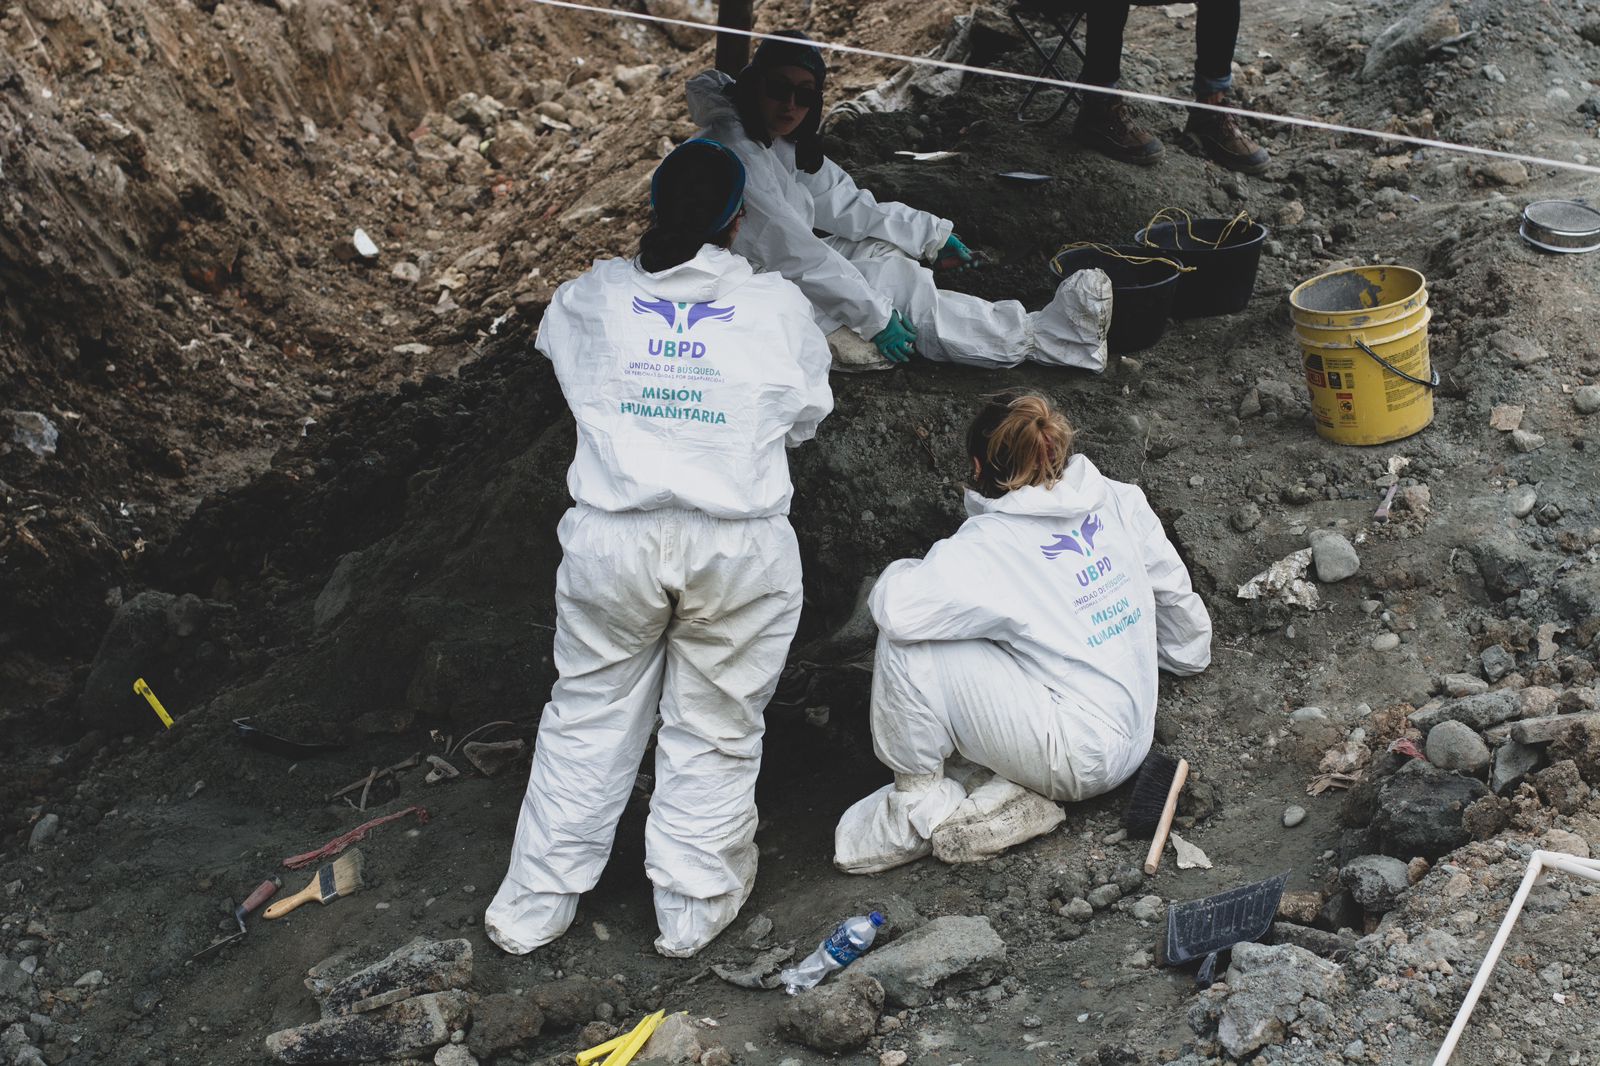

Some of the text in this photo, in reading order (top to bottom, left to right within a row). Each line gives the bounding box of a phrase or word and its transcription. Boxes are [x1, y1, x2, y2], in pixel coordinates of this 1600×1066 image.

[648, 339, 706, 358] UBPD
[629, 361, 661, 371] UNIDAD
[663, 364, 675, 373] DE
[642, 385, 702, 402] MISIÓN
[620, 402, 727, 424] HUMANITARIA
[1075, 556, 1112, 587] UBPD
